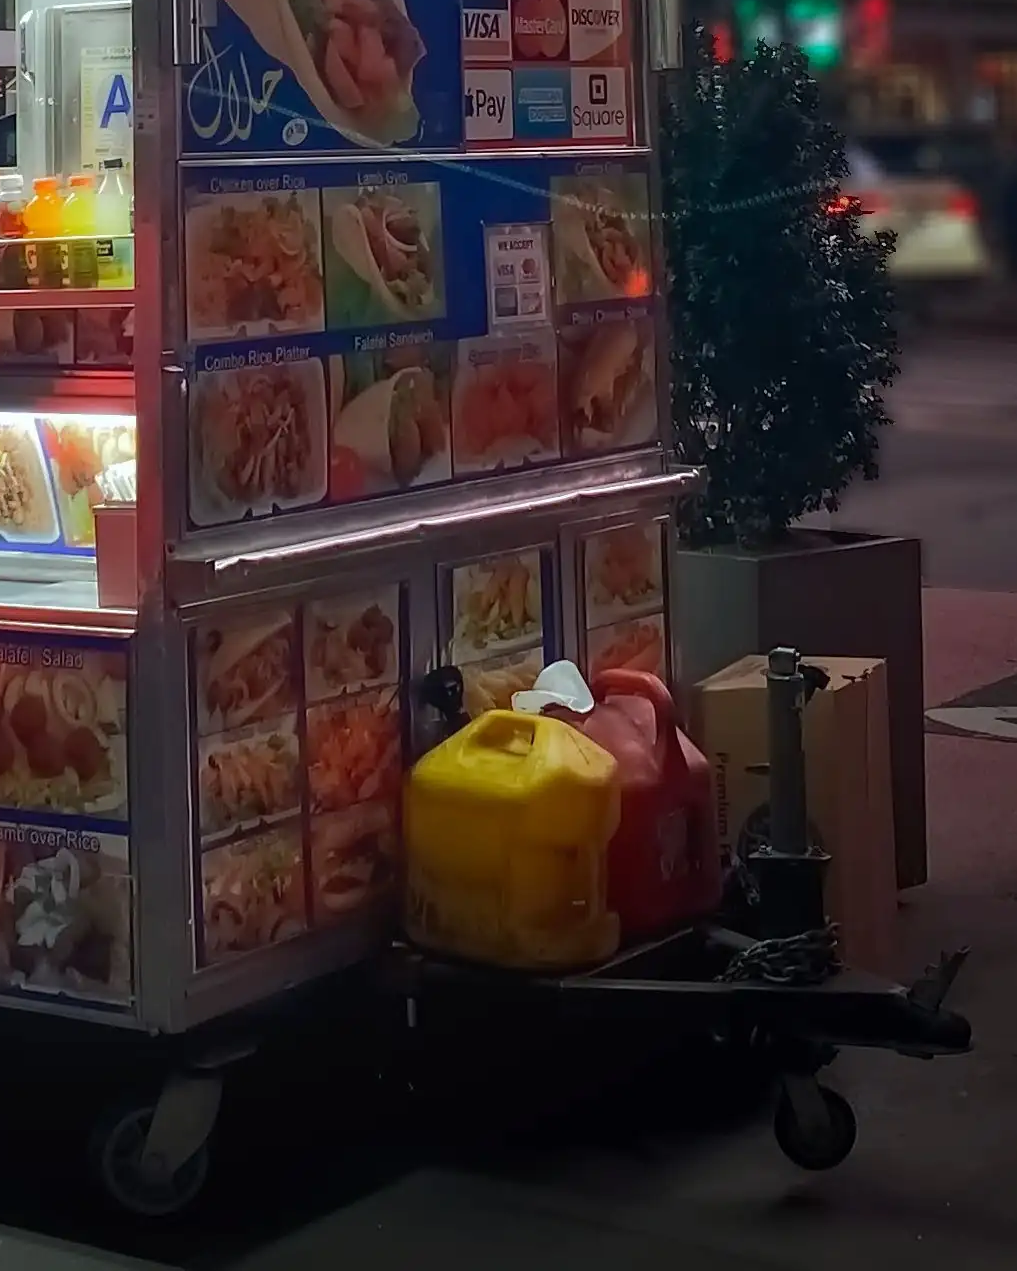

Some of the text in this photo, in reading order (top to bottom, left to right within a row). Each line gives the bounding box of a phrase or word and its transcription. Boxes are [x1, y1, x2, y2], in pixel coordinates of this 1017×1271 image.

[464, 12, 501, 39] VISA
[514, 16, 566, 35] MasterCard
[571, 8, 621, 27] DISCOVER
[99, 74, 131, 128] A
[475, 89, 507, 123] Pay
[572, 105, 625, 130] Square
[256, 178, 281, 191] over
[283, 173, 307, 189] Rice
[358, 169, 409, 187] Lamb Gyro
[354, 329, 434, 352] Falafel Sandwich
[204, 345, 311, 371] Combo Rice Platter
[41, 648, 84, 669] Salad
[30, 831, 61, 847] over
[66, 830, 101, 853] Rice
